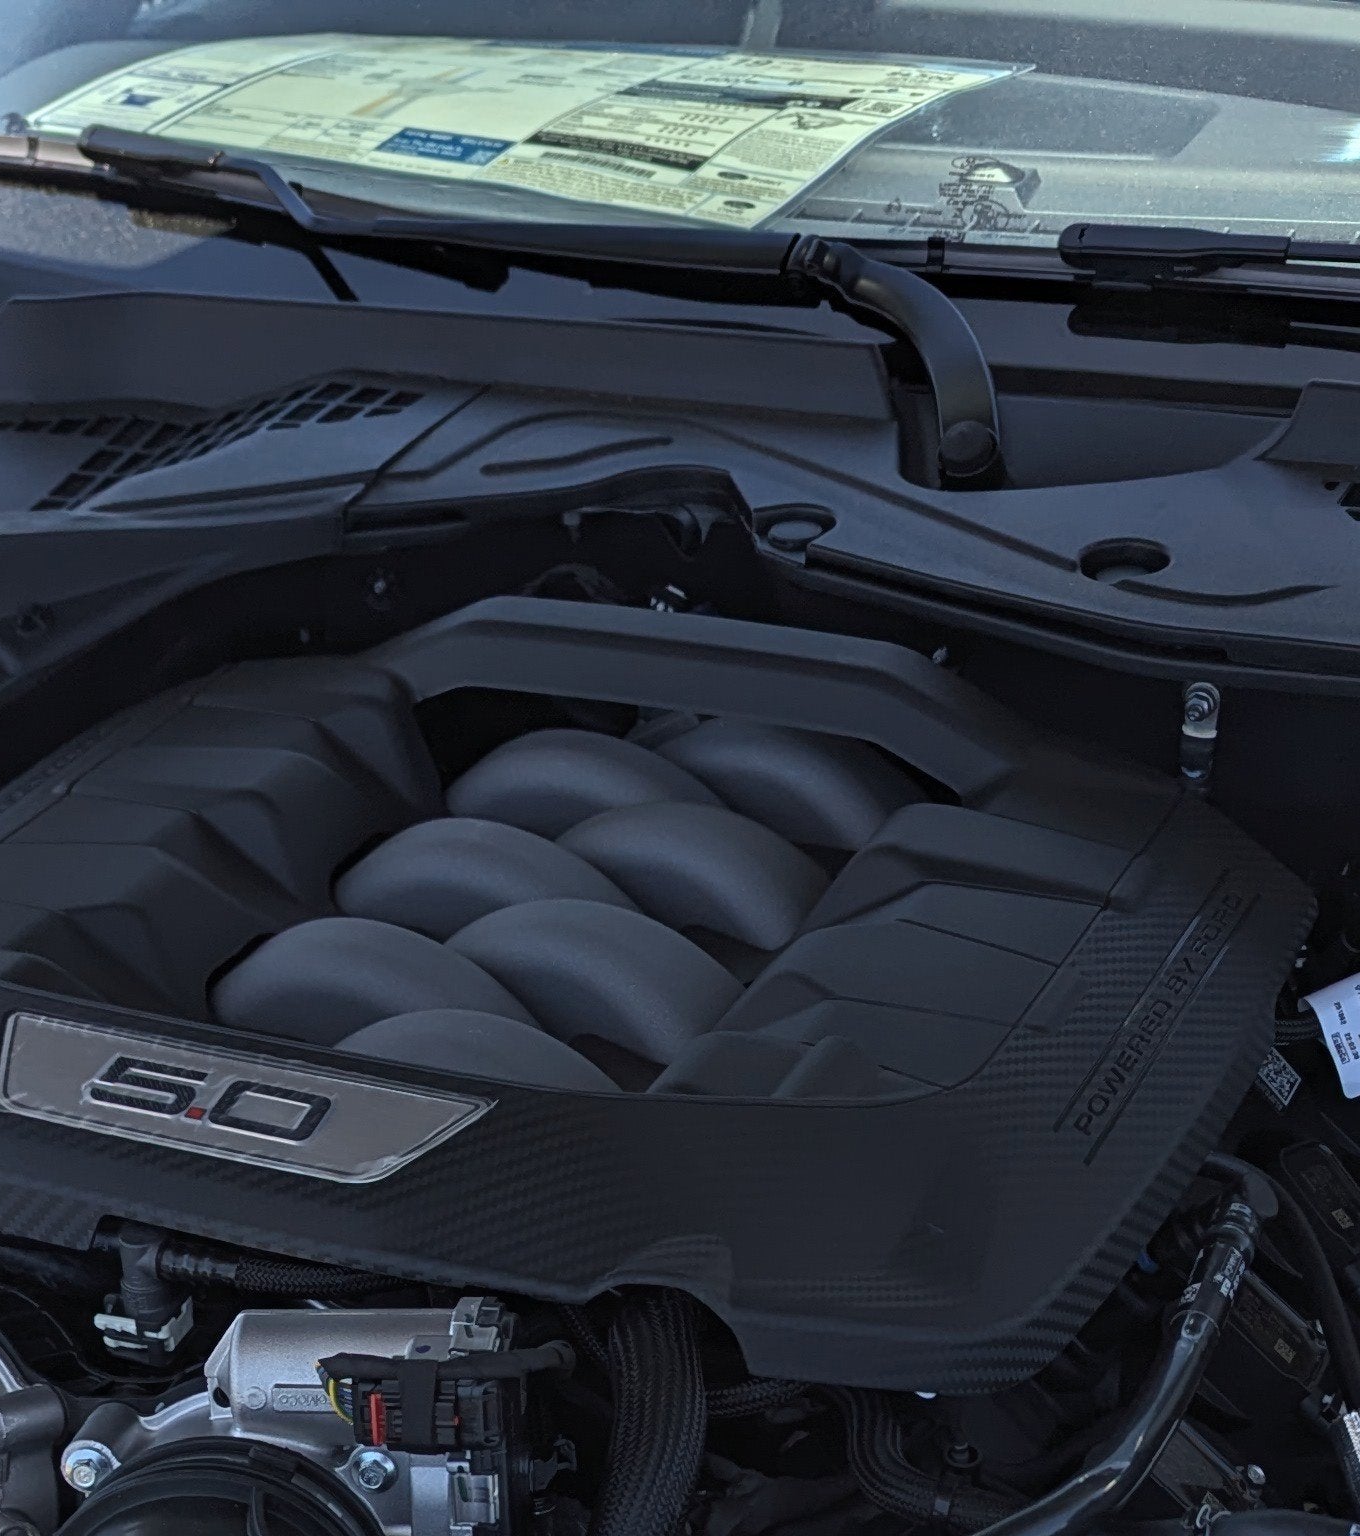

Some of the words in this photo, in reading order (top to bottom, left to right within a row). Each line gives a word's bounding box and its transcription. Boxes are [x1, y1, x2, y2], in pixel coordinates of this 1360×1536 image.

[86, 1054, 334, 1143] 5.0
[1073, 999, 1173, 1137] POWERED
[1163, 956, 1195, 995] BY
[1192, 894, 1243, 957] FORD
